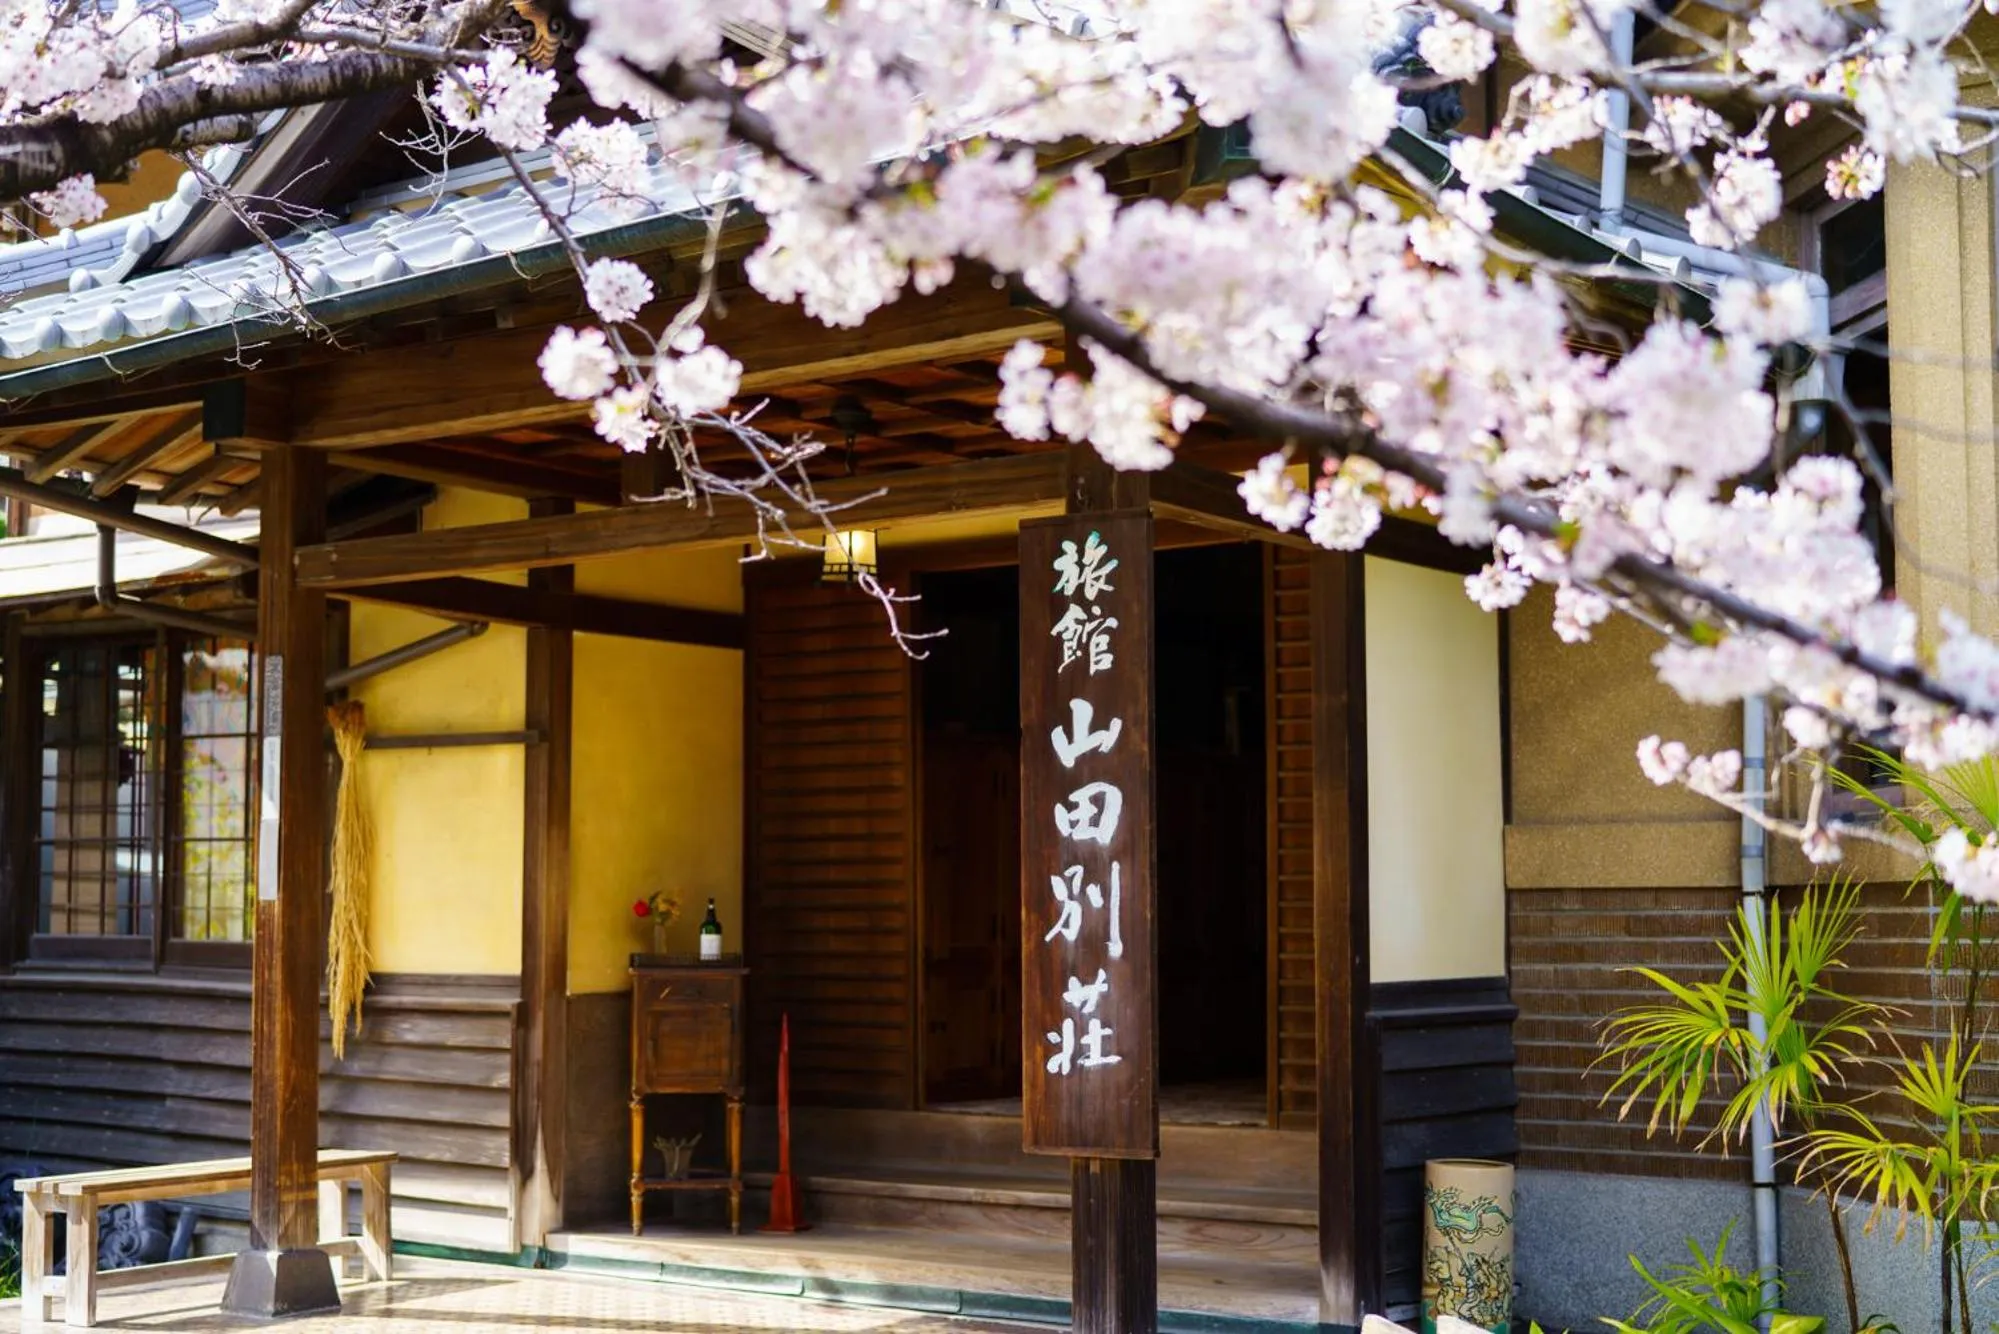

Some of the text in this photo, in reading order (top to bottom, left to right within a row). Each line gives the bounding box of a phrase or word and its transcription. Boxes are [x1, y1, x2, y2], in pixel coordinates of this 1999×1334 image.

[1046, 532, 1123, 1075] 旅館 山田別荘
